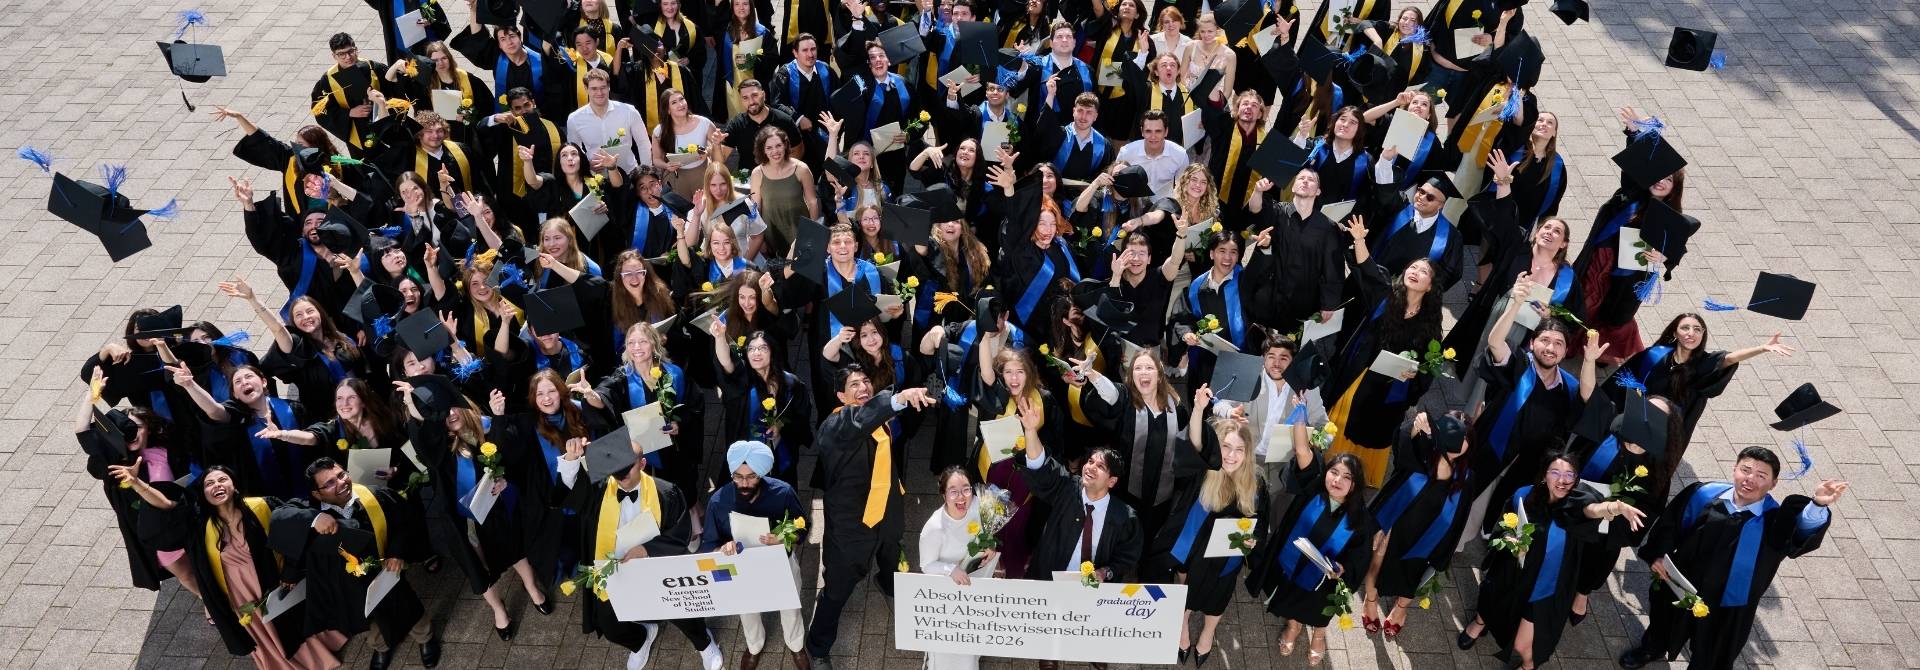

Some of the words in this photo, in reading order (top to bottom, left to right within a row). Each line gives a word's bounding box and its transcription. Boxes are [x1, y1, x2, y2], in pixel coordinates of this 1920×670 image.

[663, 574, 709, 588] ens
[914, 588, 1047, 606] Absolventinnen
[1096, 597, 1151, 607] graduation
[914, 604, 946, 614] und
[952, 605, 1056, 620] Absolventen
[1062, 610, 1091, 622] der
[1125, 605, 1156, 619] day
[914, 616, 1162, 638] Wirtschaftswissenschaftlichen
[914, 629, 982, 644] Fakultät
[985, 635, 1024, 646] 2026
